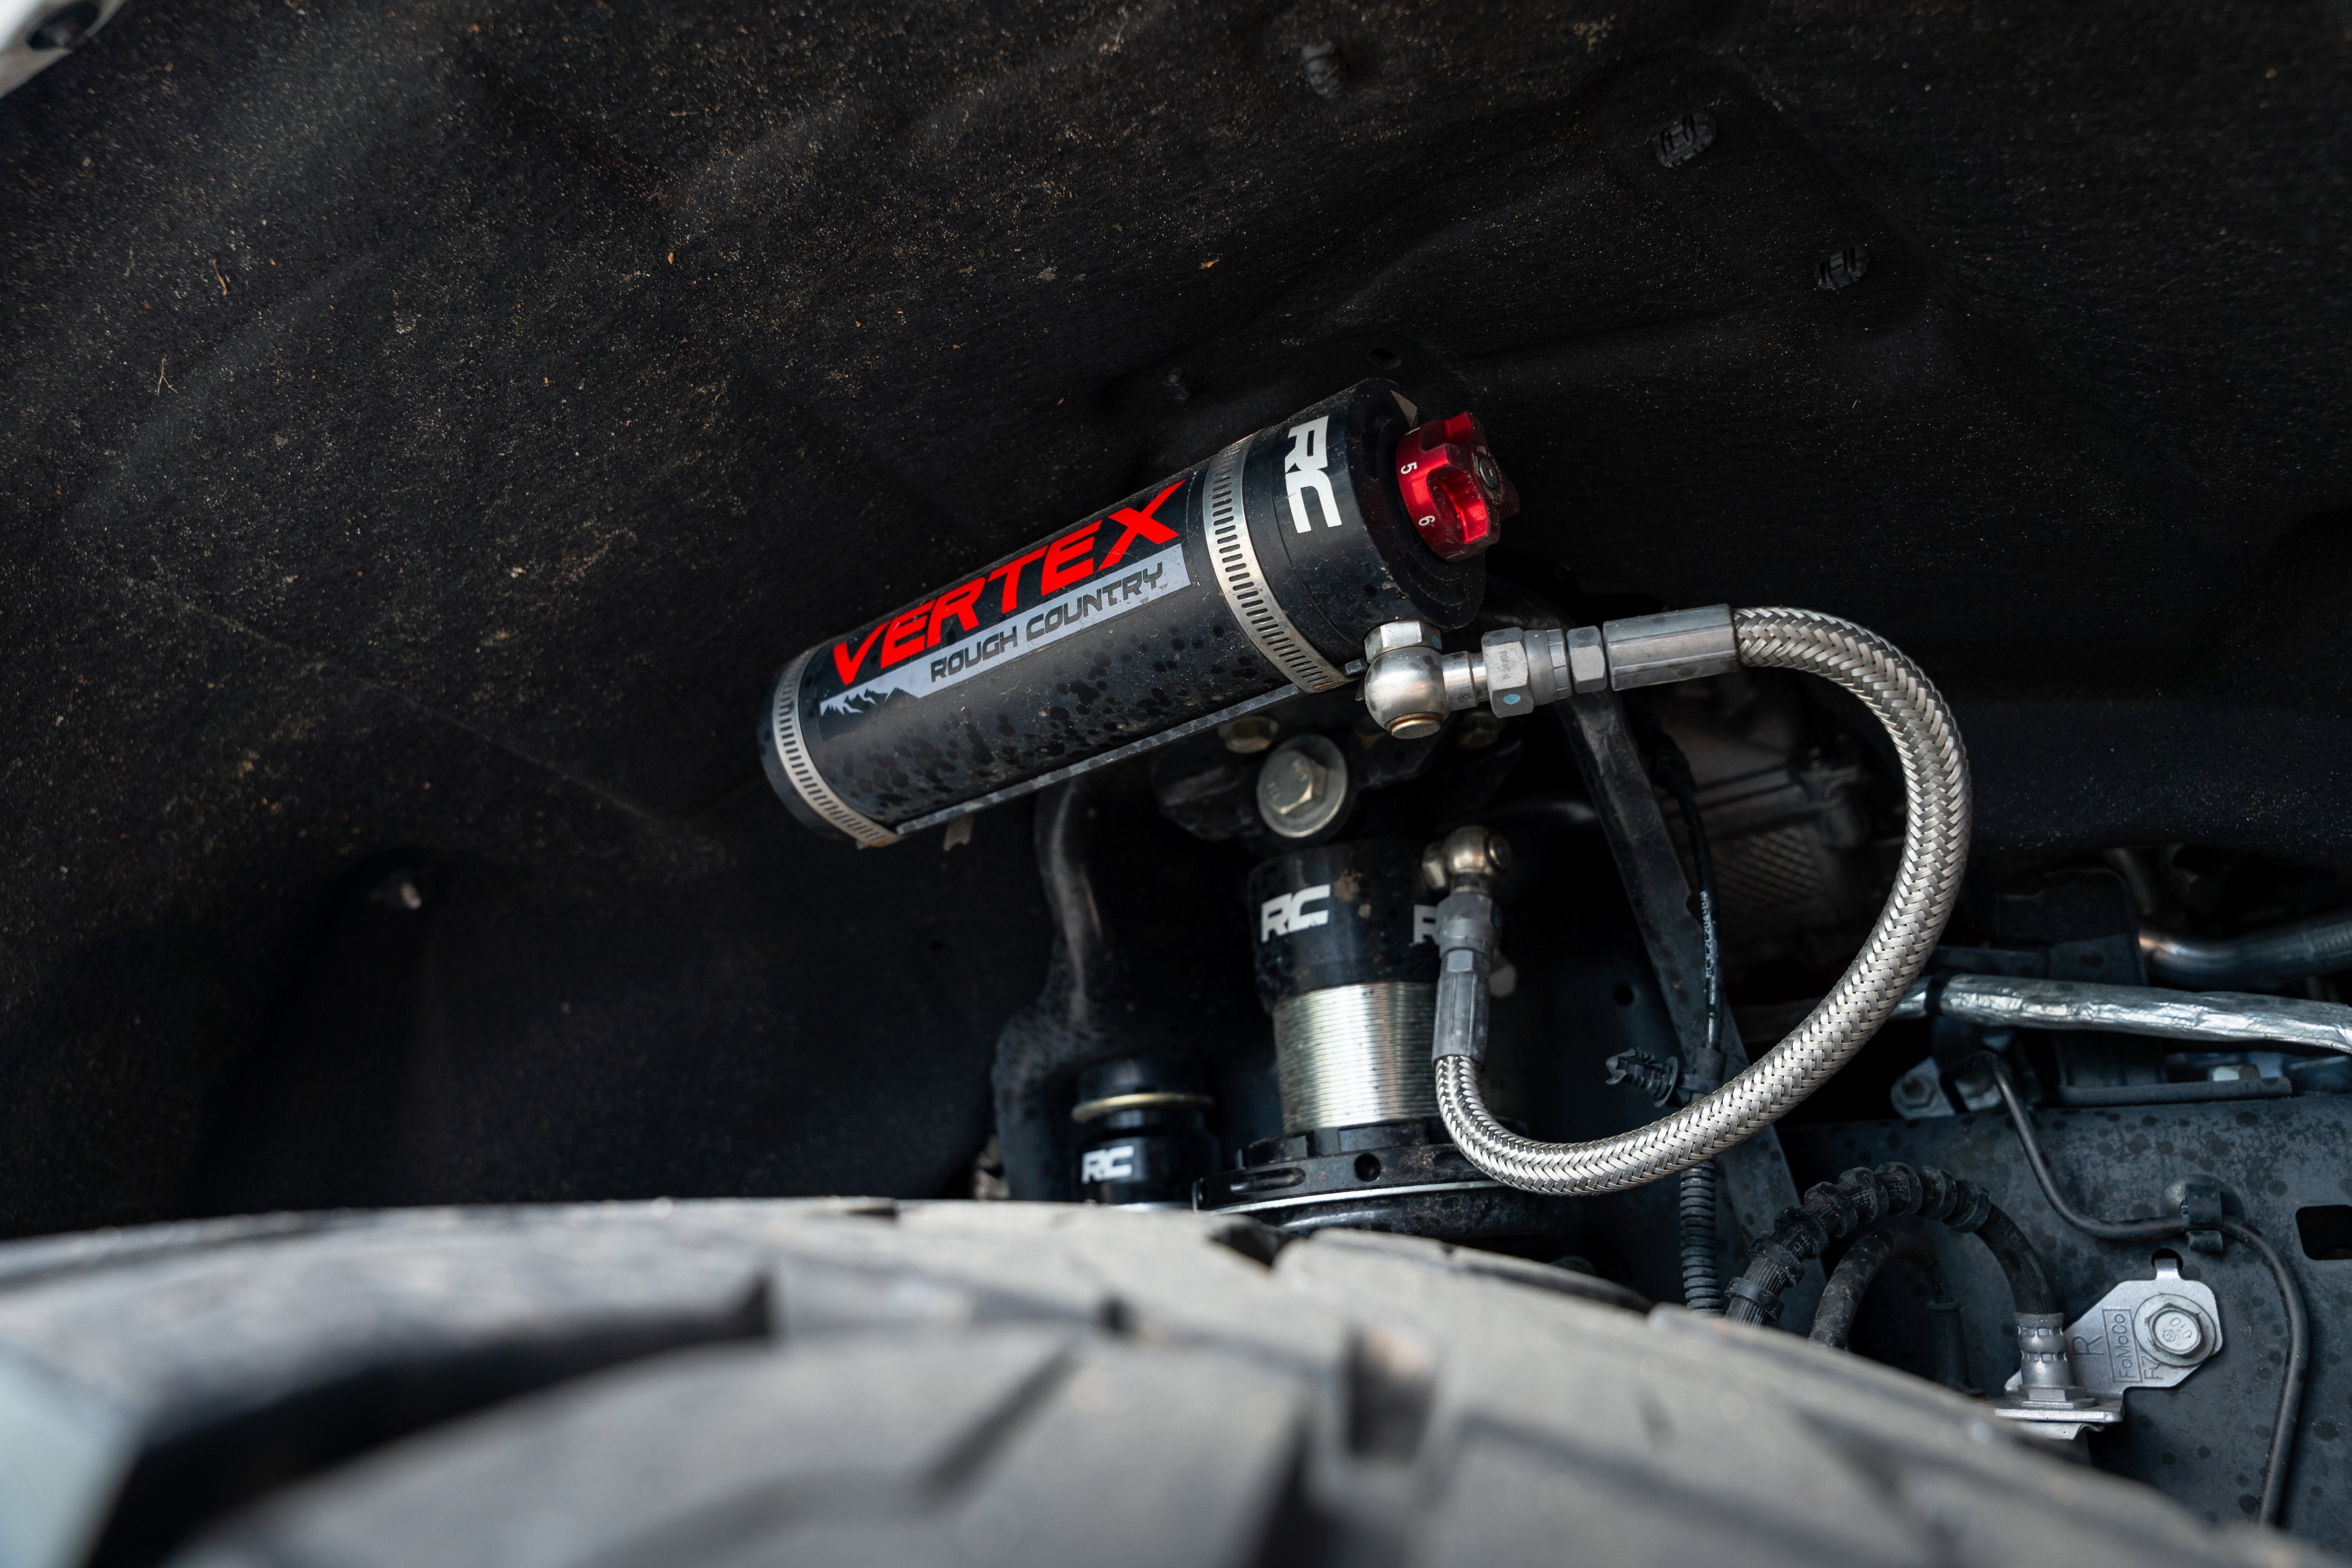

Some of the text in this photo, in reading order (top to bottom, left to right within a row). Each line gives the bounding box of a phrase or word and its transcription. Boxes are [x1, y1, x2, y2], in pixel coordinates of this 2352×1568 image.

[1285, 415, 1342, 533] RC
[1401, 461, 1417, 474] 5
[1418, 515, 1436, 526] 6
[833, 479, 1186, 686] VERTEX
[931, 562, 1163, 683] ROUGH COUNTRY
[1261, 884, 1331, 944] RC
[1413, 904, 1441, 945] R
[1081, 1145, 1135, 1185] RC
[2071, 1336, 2105, 1356] R
[2112, 1314, 2135, 1379] FoMoCo
